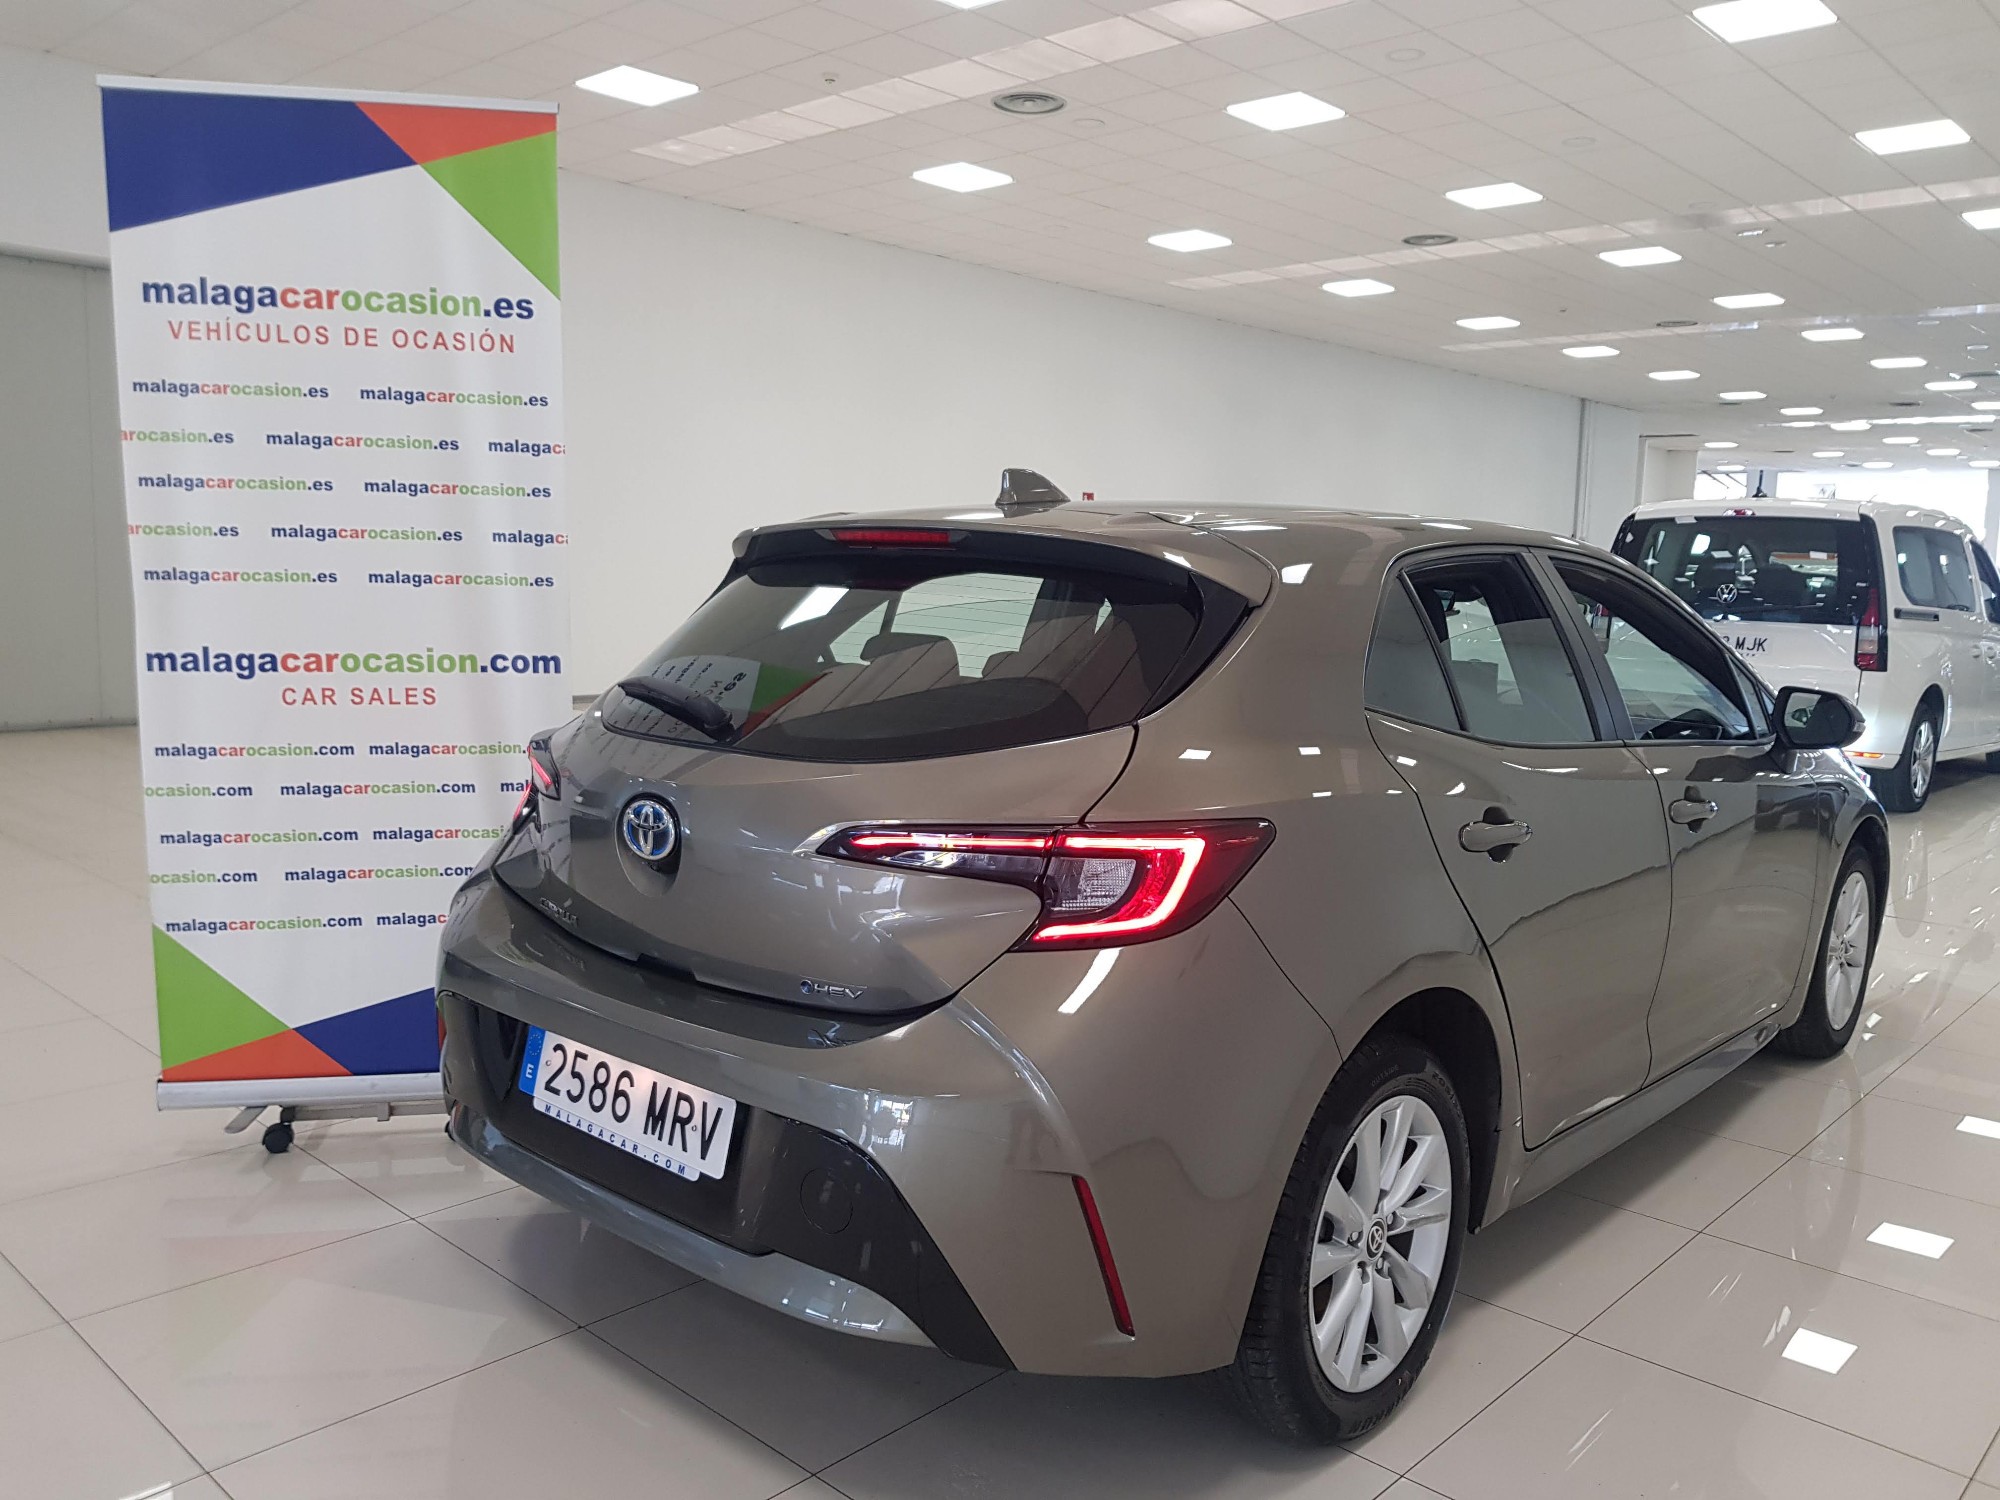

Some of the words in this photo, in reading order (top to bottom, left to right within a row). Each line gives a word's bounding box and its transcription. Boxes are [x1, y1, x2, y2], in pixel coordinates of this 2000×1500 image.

[141, 276, 536, 320] malagacarocasion.es
[167, 316, 330, 346] VEHÍCULOS
[344, 325, 379, 348] DE
[391, 326, 517, 355] OCASIÓN
[132, 378, 330, 399] malagacarocasion.es
[359, 386, 549, 407] malagacarocasion.es
[266, 431, 460, 451] malagacarocasion.es
[137, 473, 334, 492] malagacarocasion.es
[364, 478, 552, 498] malagacarocasion.es
[270, 523, 463, 543] malagacarocasion.es
[143, 566, 338, 585] malagacarocasion.es
[368, 570, 555, 588] malagacarocasion.es
[1735, 636, 1768, 652] MJK
[145, 645, 562, 681] malagacarocasion.com
[281, 686, 338, 706] CAR
[350, 686, 437, 707] SALES
[154, 742, 355, 760] malagacarocasion.com
[368, 739, 527, 757] malagacarocasion.
[145, 783, 254, 799] ocasion.com
[280, 780, 476, 799] malagacarocasion.com
[159, 829, 359, 847] malagacarocasion.com
[149, 872, 259, 885] ocasion.com
[165, 915, 363, 932] malagacarocasion.com
[376, 912, 449, 930] malagac
[814, 983, 864, 1000] HEV
[525, 1063, 535, 1079] E
[544, 1043, 635, 1124] 2586
[643, 1081, 724, 1162] MRV
[544, 1104, 686, 1176] MALAGACAR.COM
